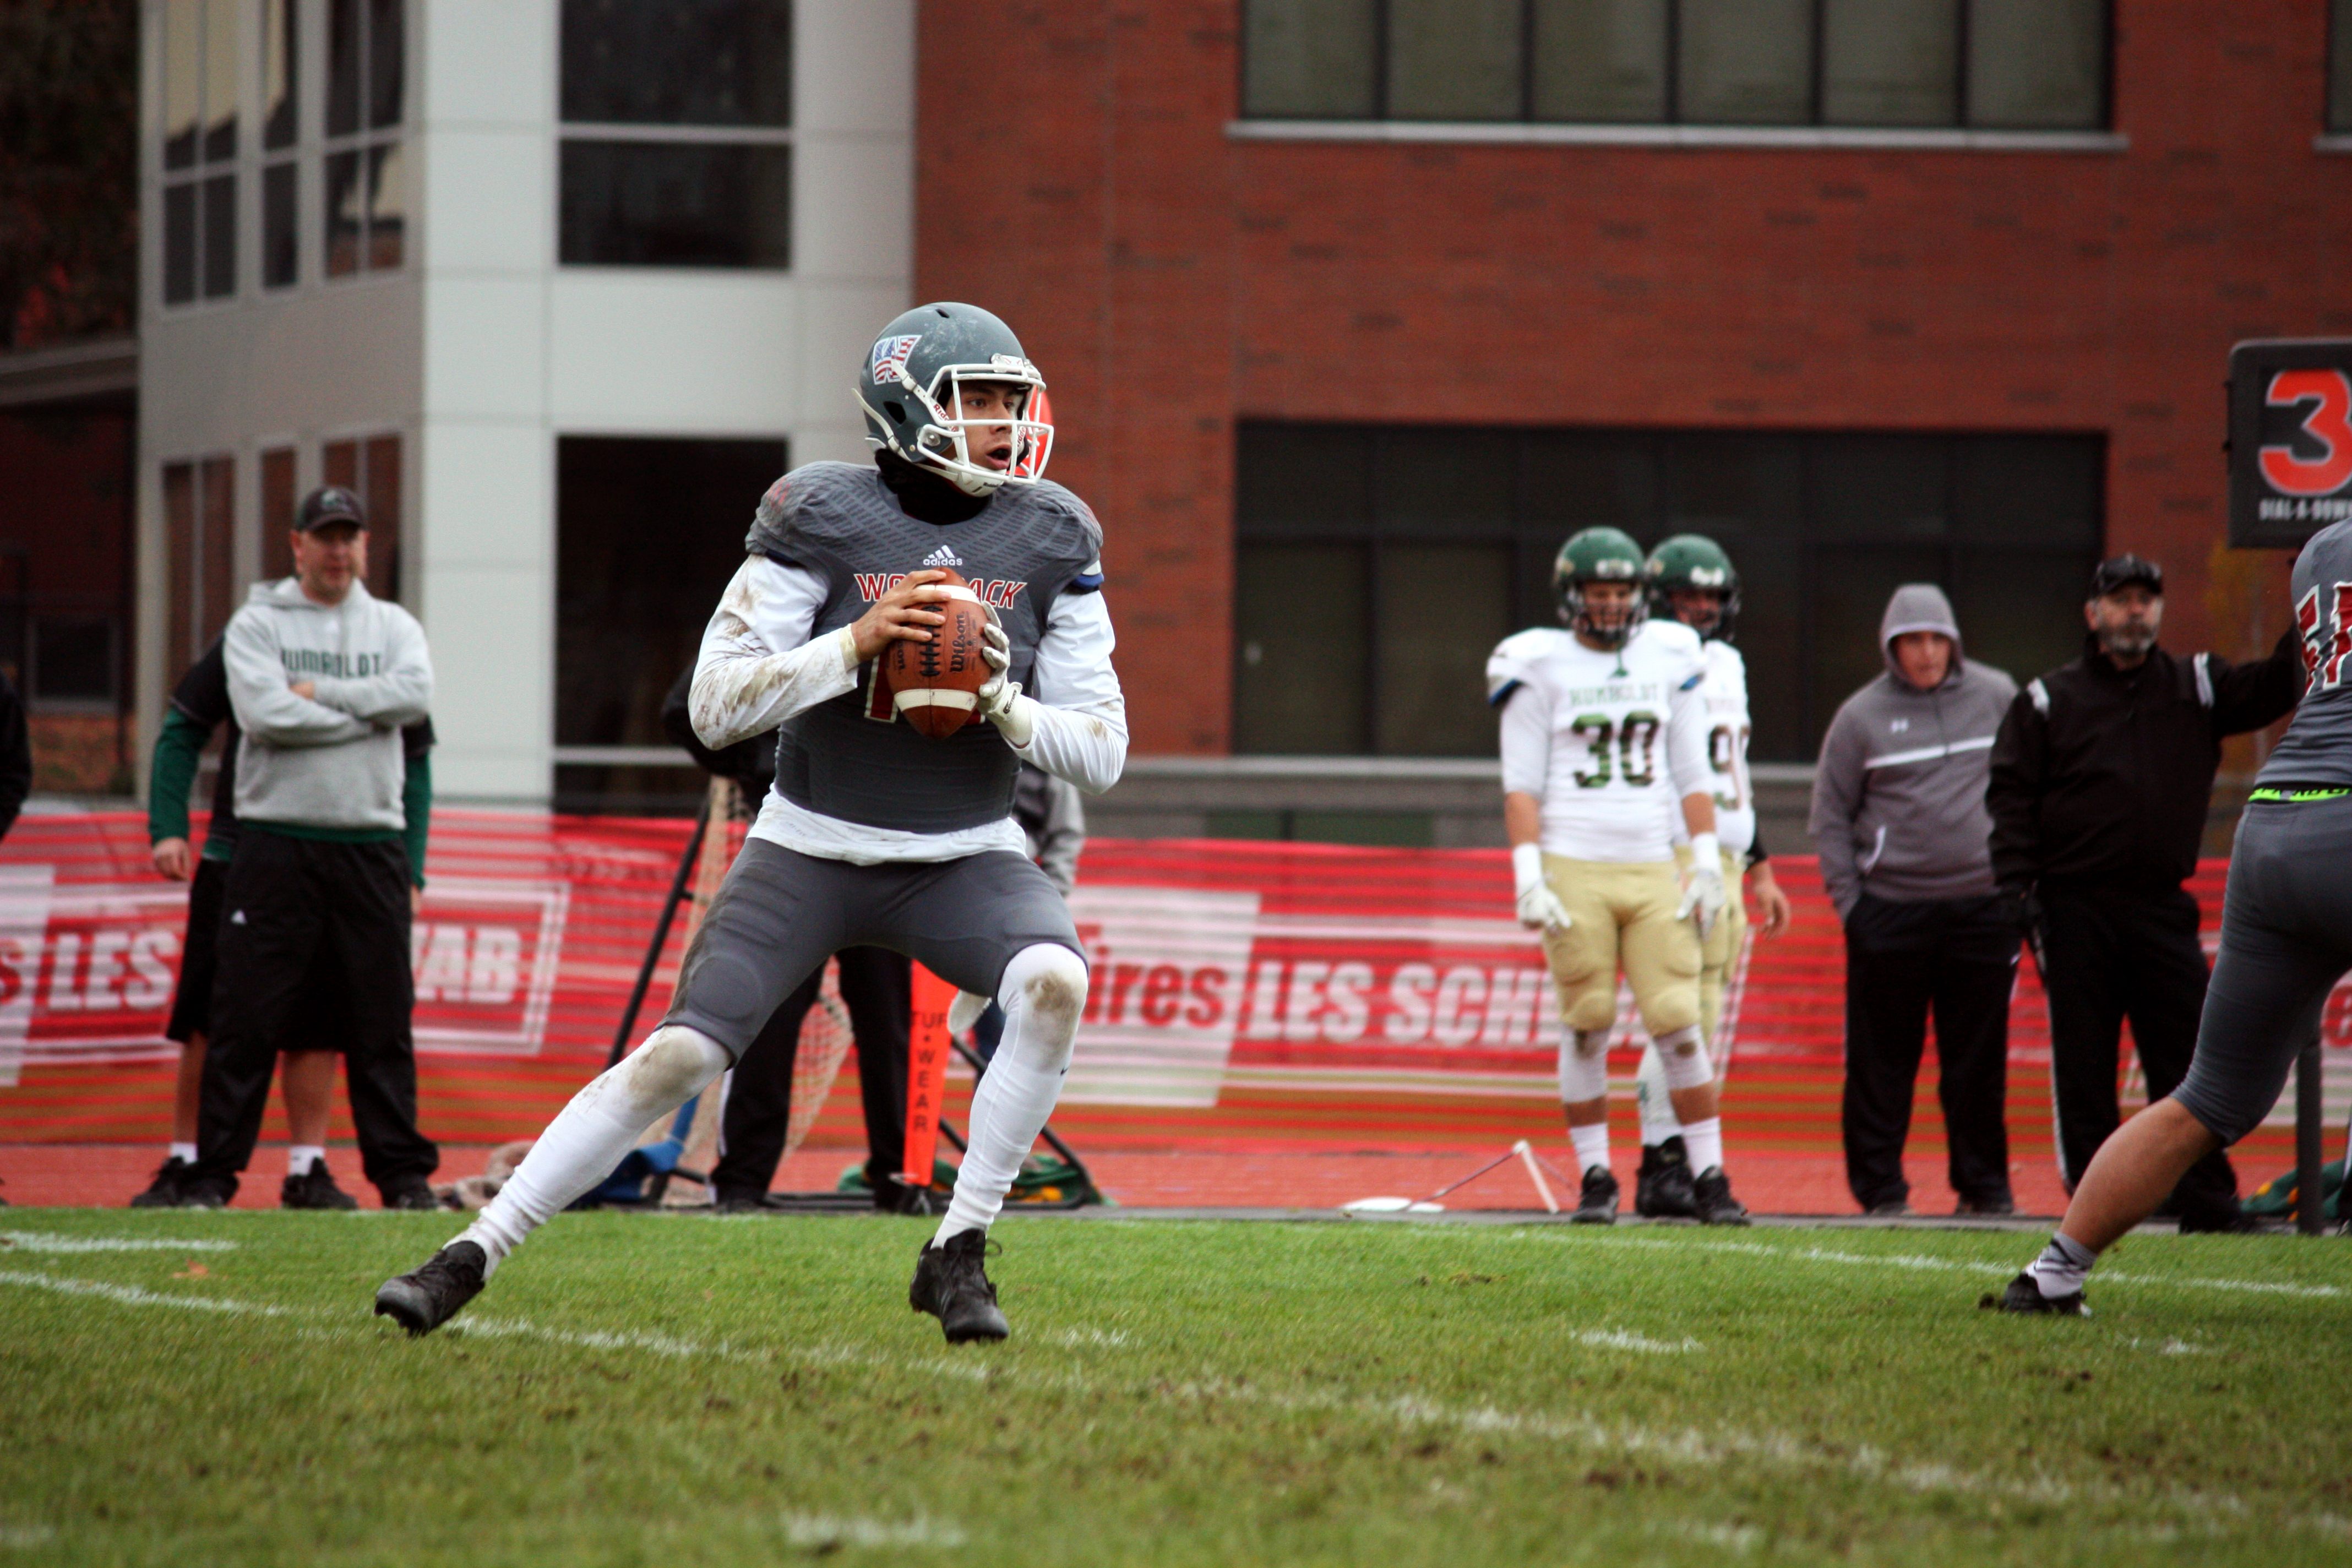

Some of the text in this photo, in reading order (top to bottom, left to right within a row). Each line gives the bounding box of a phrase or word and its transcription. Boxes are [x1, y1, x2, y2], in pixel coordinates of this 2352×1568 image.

[2258, 368, 2352, 496] 3
[853, 573, 1027, 609] WOACK
[923, 557, 962, 566] adidas
[950, 614, 966, 672] Wilson
[1571, 711, 1660, 789] 30
[48, 930, 180, 1011] LES
[1243, 960, 1374, 1042] LES
